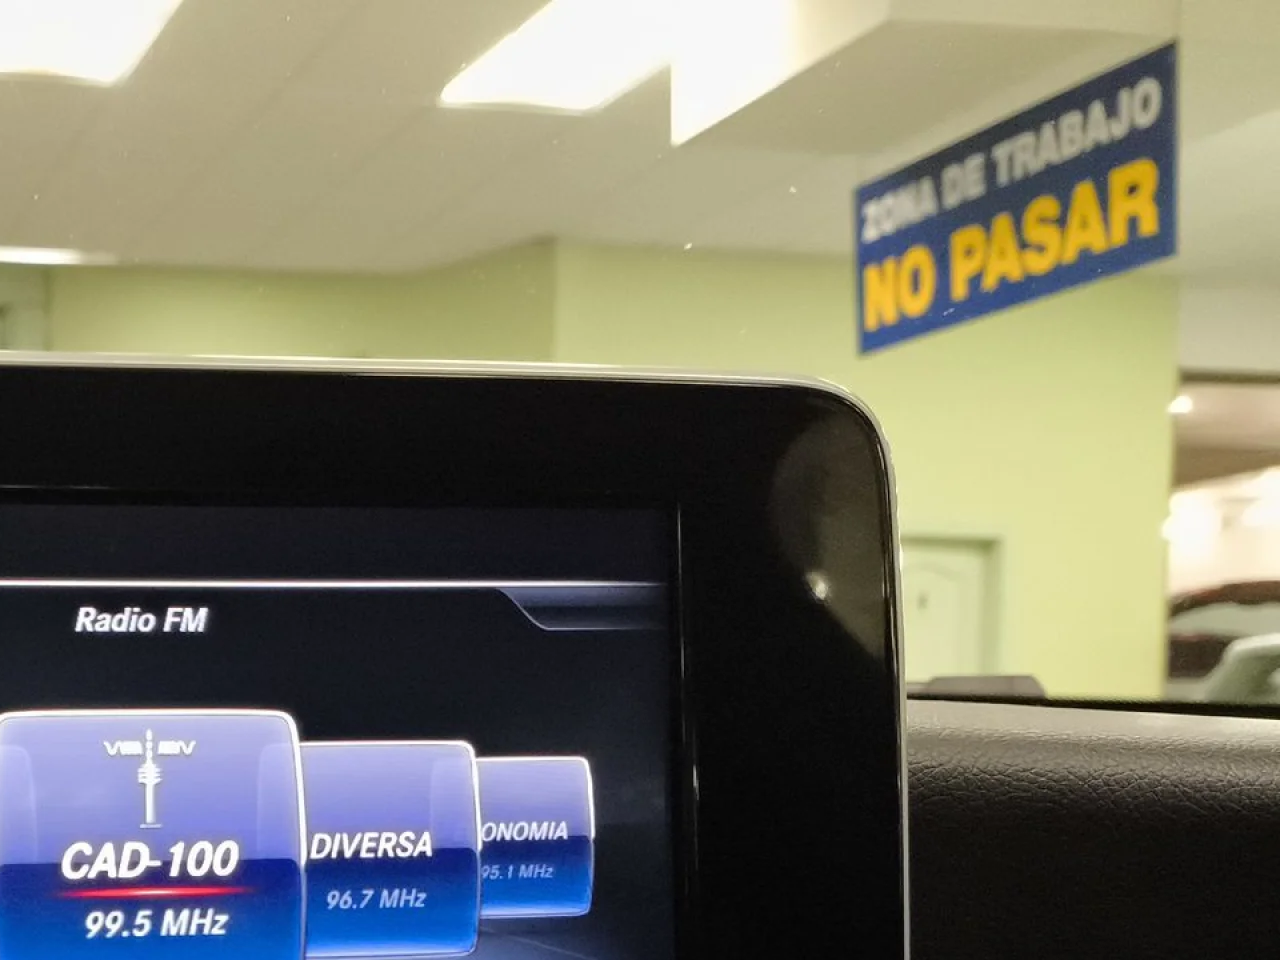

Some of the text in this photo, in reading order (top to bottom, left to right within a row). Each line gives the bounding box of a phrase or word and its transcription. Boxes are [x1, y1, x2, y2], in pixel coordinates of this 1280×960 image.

[861, 77, 1163, 244] ZONA DE TRABAJO
[863, 158, 1160, 332] NO PASAR
[75, 606, 209, 633] Radio FM
[61, 840, 239, 880] CAD-100
[310, 831, 433, 860] DIVERSA
[519, 864, 554, 879] MHz
[327, 888, 427, 910] 96.7 MHz
[85, 908, 229, 938] 99.5 MHz
